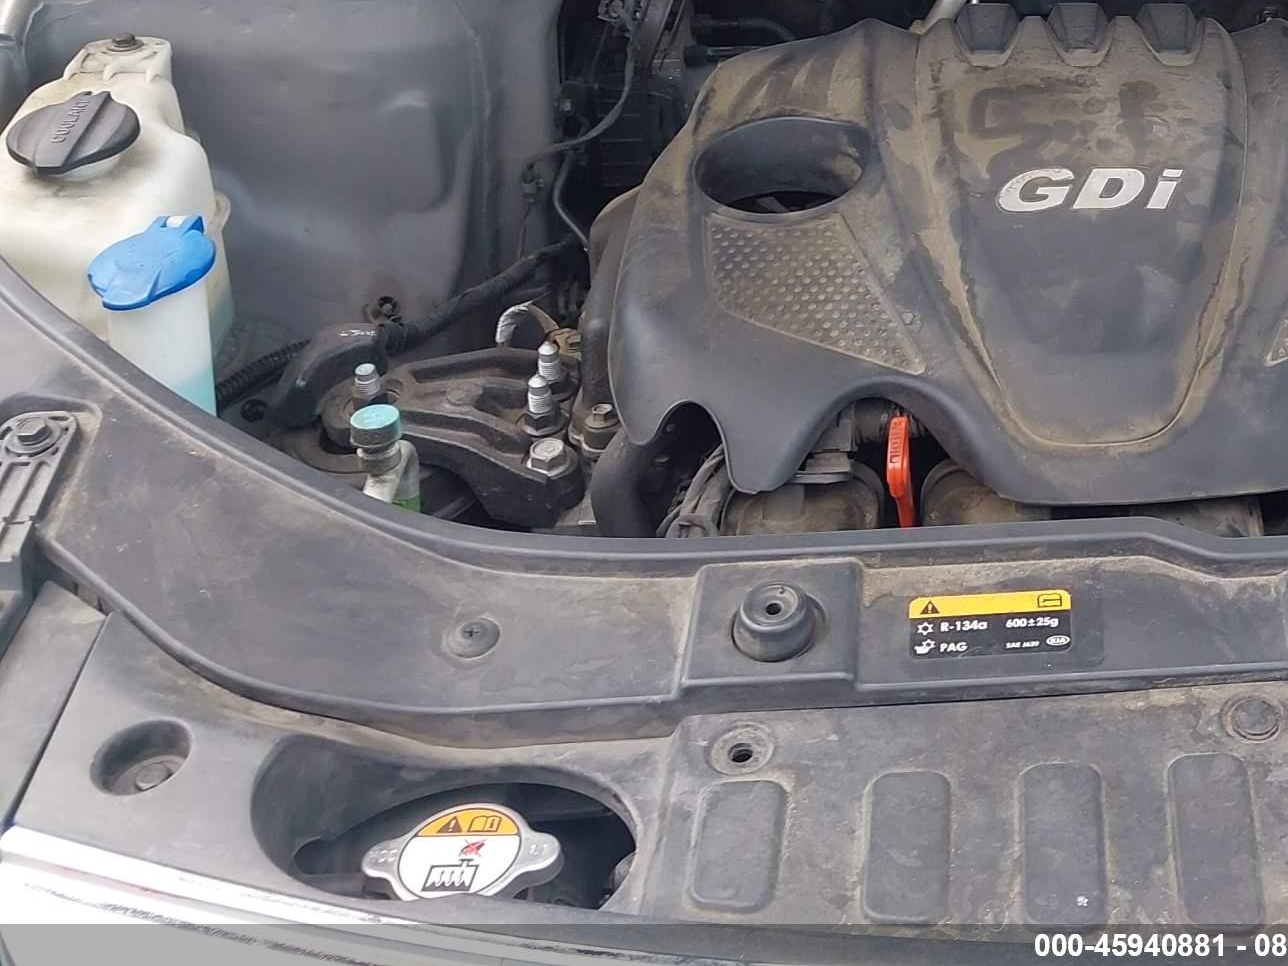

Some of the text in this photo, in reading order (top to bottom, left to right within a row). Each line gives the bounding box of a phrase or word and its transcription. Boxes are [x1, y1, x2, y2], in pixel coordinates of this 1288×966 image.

[50, 100, 90, 144] COOLANT
[997, 168, 1185, 213] GDi
[940, 616, 1059, 632] R-134a 600±25g
[939, 641, 968, 652] PAG
